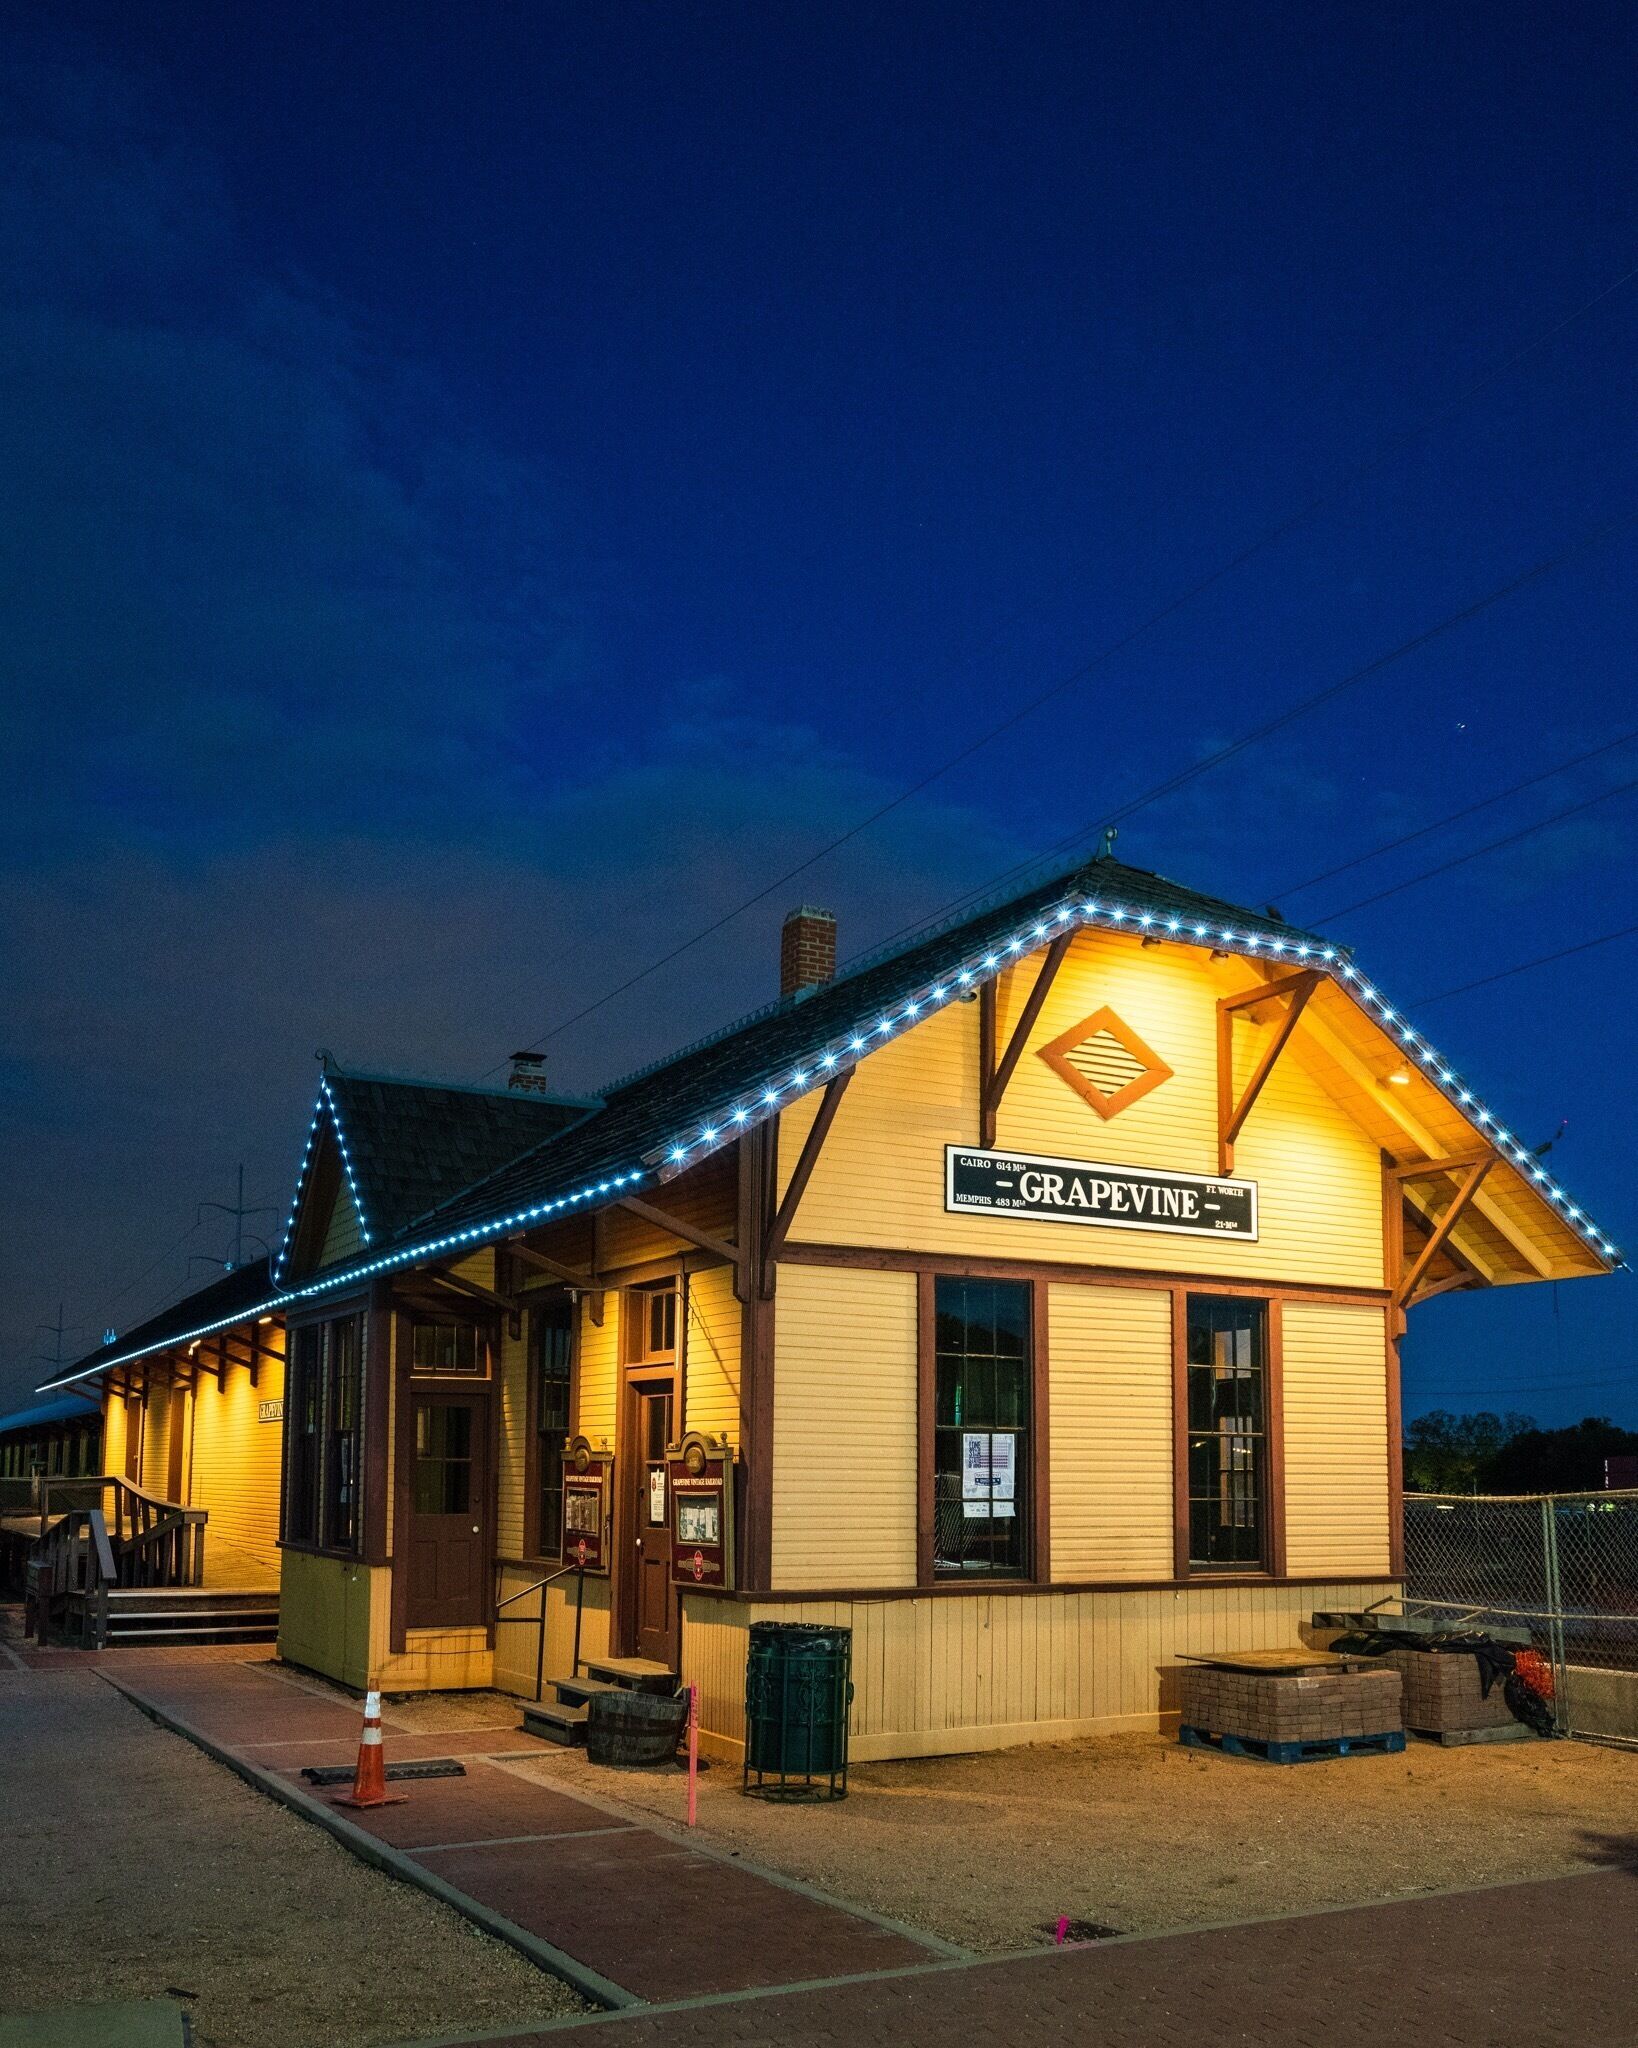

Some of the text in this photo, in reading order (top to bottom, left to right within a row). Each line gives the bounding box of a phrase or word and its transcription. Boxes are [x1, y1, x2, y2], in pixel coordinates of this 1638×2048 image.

[960, 1157, 991, 1169] CAIRO
[996, 1161, 1012, 1171] 614
[1019, 1171, 1200, 1219] GRAPEVINE
[1217, 1186, 1244, 1197] WORTH
[955, 1193, 992, 1205] MEMPHIS
[995, 1197, 1010, 1207] 483
